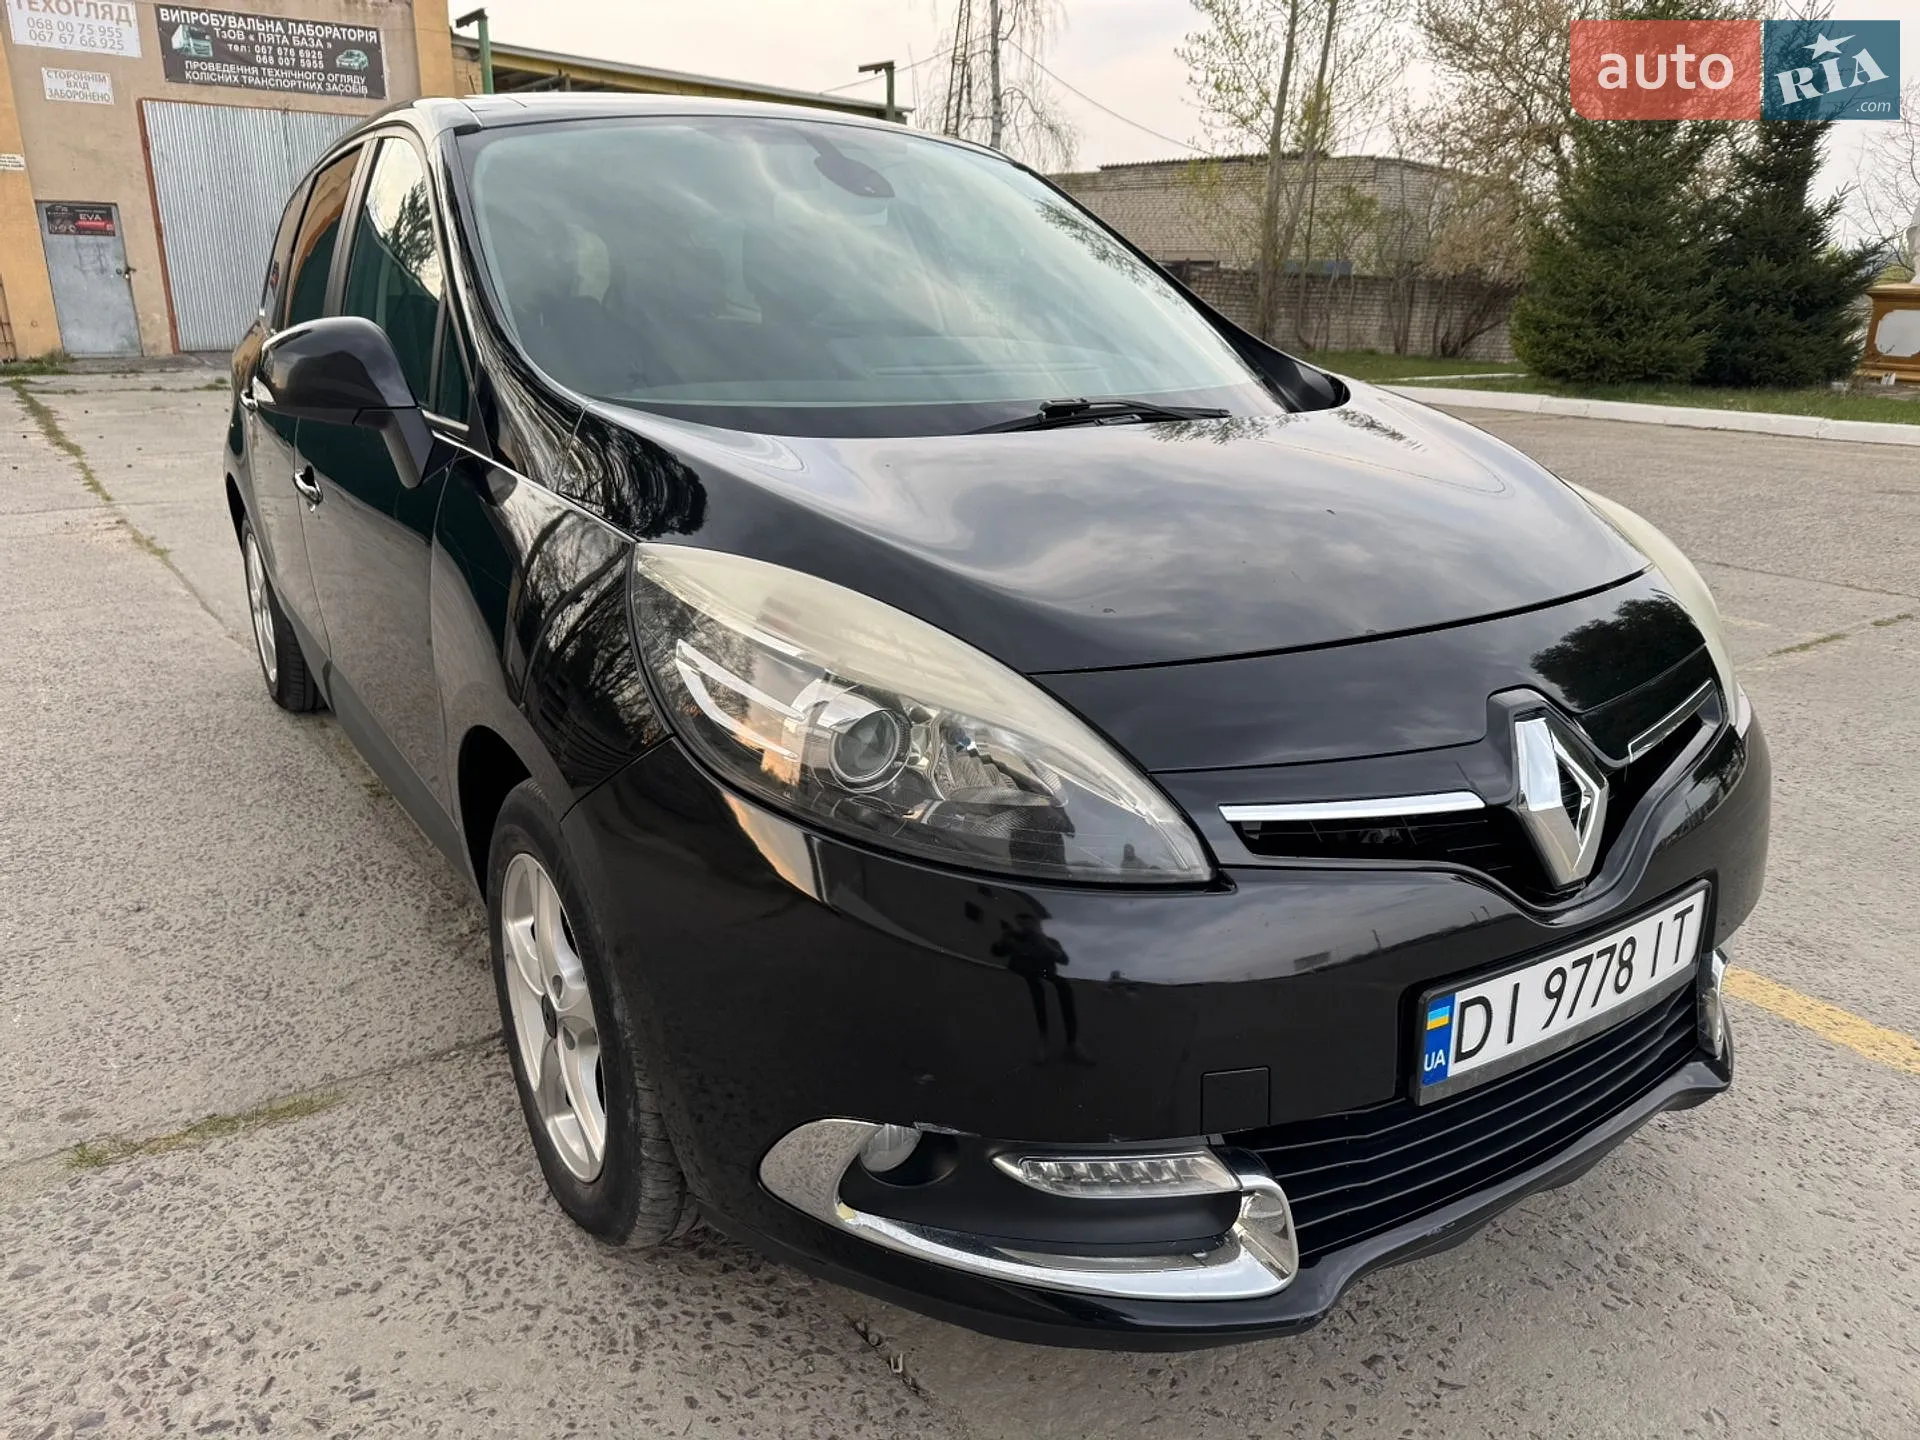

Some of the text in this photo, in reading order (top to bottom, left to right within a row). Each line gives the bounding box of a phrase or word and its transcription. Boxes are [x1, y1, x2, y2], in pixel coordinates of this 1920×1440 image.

[26, 16, 123, 39] 068 00 75 955
[160, 8, 378, 44] ВИПРОБУВАЛЬНА ЛАБОРАТОРІЯ
[28, 29, 125, 51] 067 67 66 925
[258, 32, 290, 46] ПЯТА
[292, 36, 324, 49] БАЗА
[184, 60, 367, 85] ПРОВЕДЕННЯ ТЕХНІЧНОГО ОГЛЯДУ
[184, 70, 368, 95] КОЛІСНИХ ТРАНСПОРТНИХ ЗАСОБІВ
[79, 213, 102, 221] EVA
[1453, 904, 1694, 1064] DI 9778 IT
[1424, 1048, 1446, 1072] UA
